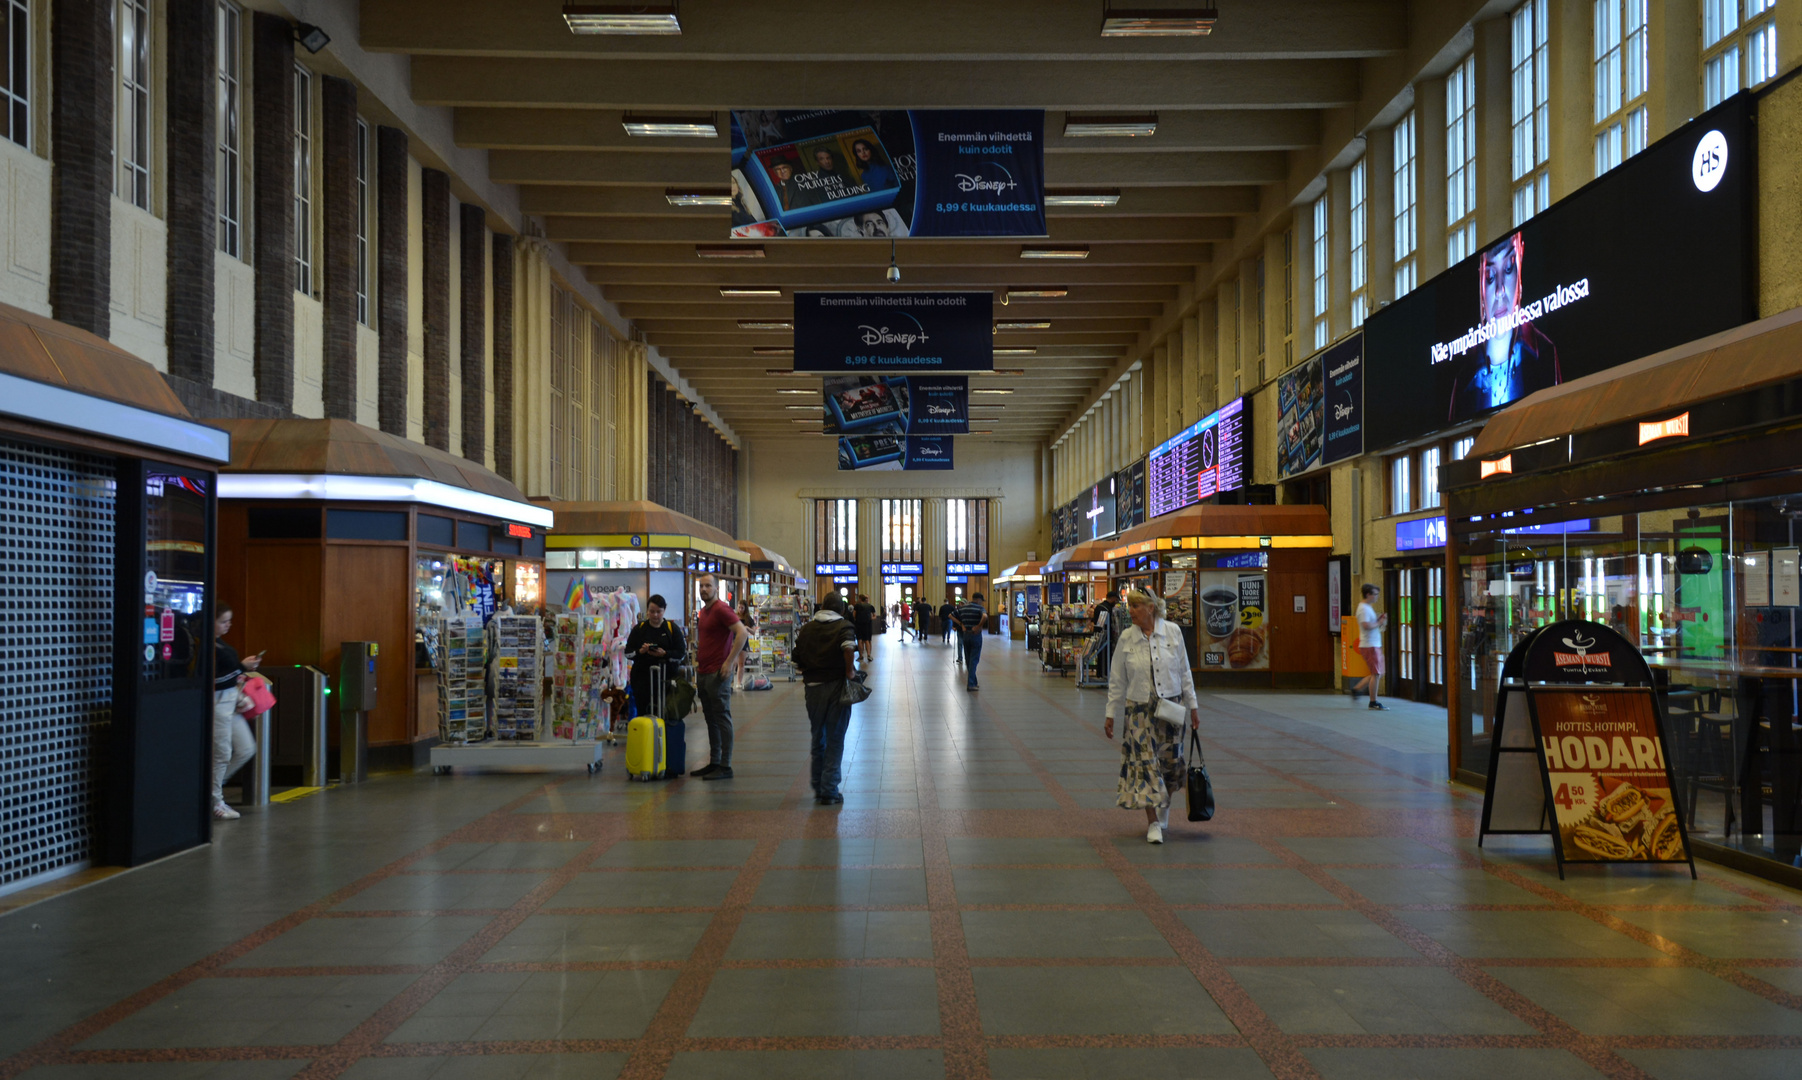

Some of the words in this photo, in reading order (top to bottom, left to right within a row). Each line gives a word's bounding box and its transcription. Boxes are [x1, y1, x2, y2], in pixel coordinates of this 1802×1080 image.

[938, 132, 987, 142] Enemmän
[989, 132, 1032, 142] viihdettä
[959, 144, 980, 154] kuin
[982, 144, 1012, 154] odotit
[1700, 145, 1720, 177] HS
[794, 170, 819, 183] ONLY
[798, 174, 843, 191] MURDERS
[826, 183, 870, 200] BUILDING
[954, 174, 1018, 196] Disney+
[936, 203, 959, 213] 8,99
[961, 203, 968, 212] €
[970, 202, 1036, 212] kuukaudessa
[820, 297, 868, 306] Enemmän
[870, 297, 912, 306] viihdettä
[914, 297, 935, 306] kuin
[936, 297, 966, 306] odotit
[1431, 342, 1448, 365] Näe
[1448, 316, 1496, 361] ympäristö
[1496, 300, 1542, 334] uudessa
[1543, 278, 1590, 314] valossa
[858, 324, 930, 350] Disney+
[845, 356, 868, 366] 8,99
[870, 356, 876, 364] €
[878, 355, 942, 364] kuukaudessa
[873, 436, 894, 448] PREY
[632, 535, 640, 546] R
[1241, 611, 1252, 625] 2
[1556, 653, 1580, 665] ASEMAN
[1586, 652, 1610, 666] WURSTI
[1542, 736, 1666, 770] HODARI
[1554, 783, 1574, 810] 4
[1572, 786, 1584, 796] 50
